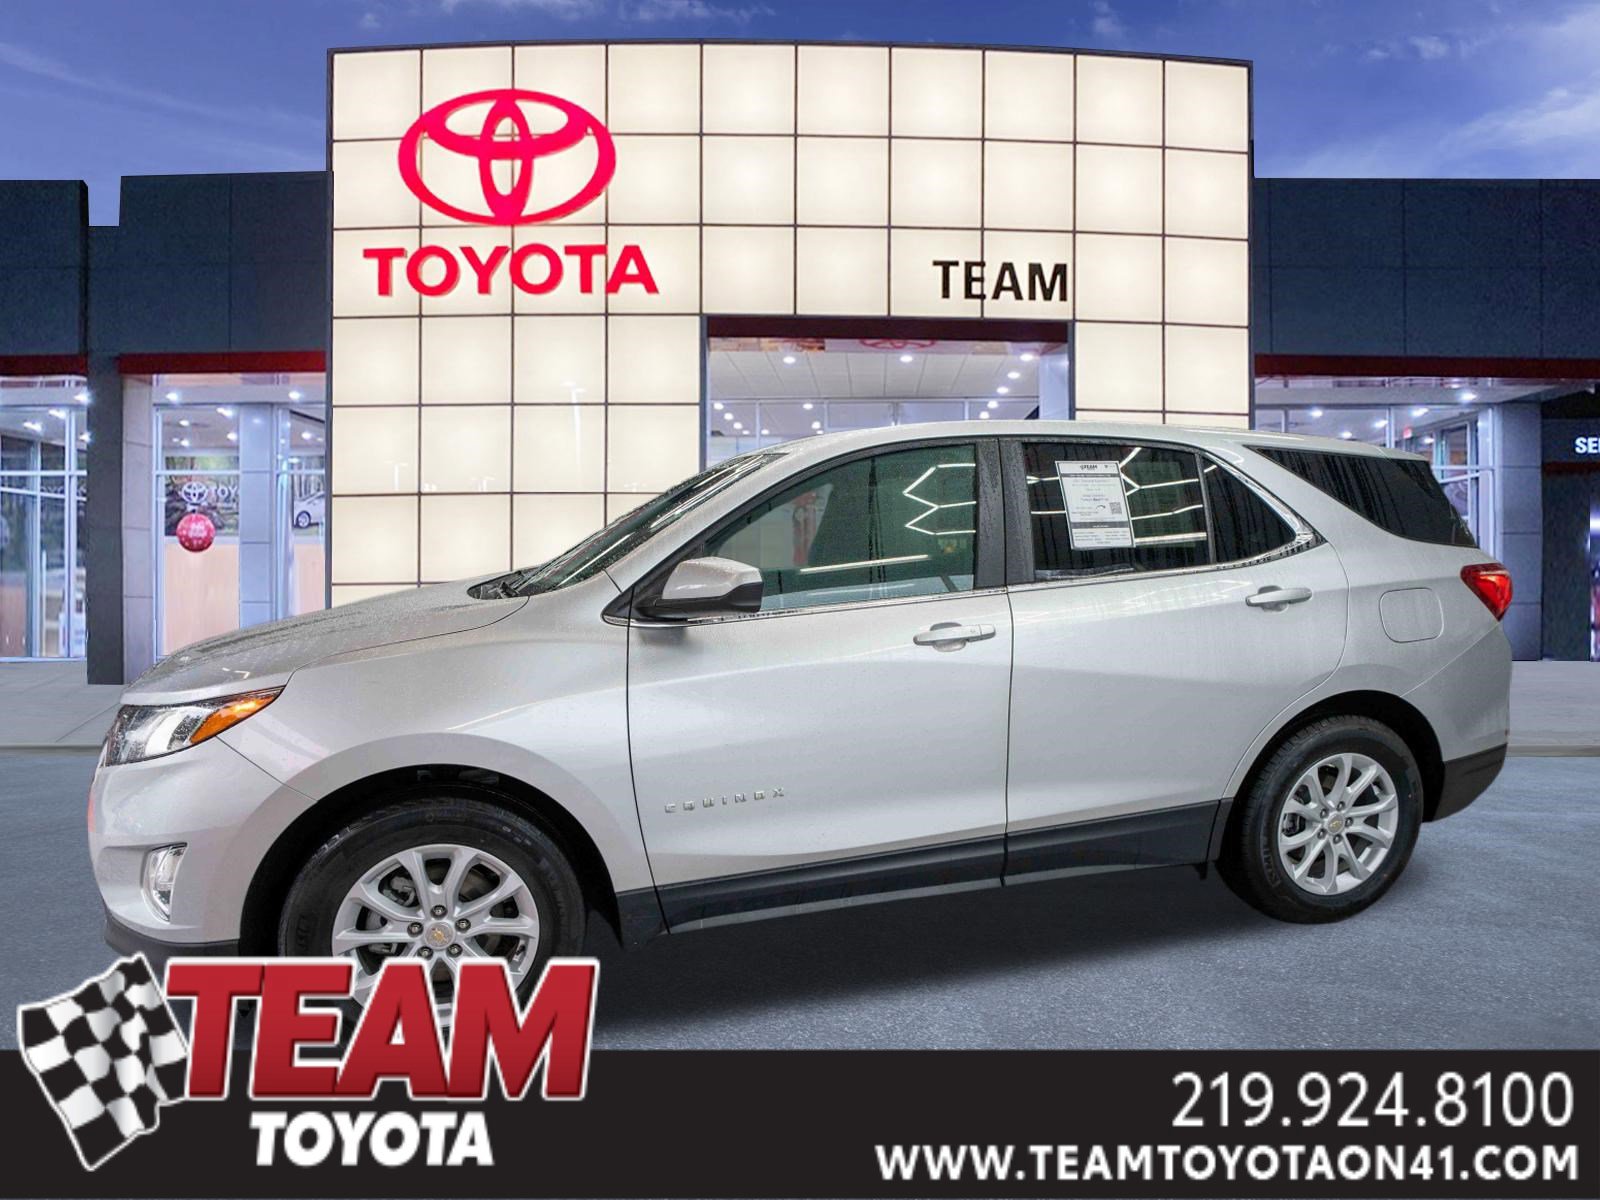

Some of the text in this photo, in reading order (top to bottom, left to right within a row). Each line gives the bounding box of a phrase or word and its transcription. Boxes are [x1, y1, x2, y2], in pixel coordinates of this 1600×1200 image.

[363, 243, 659, 296] TOYOTA
[932, 260, 1067, 301] TEAM
[1575, 437, 1600, 454] SE
[664, 787, 785, 813] EQUINOX
